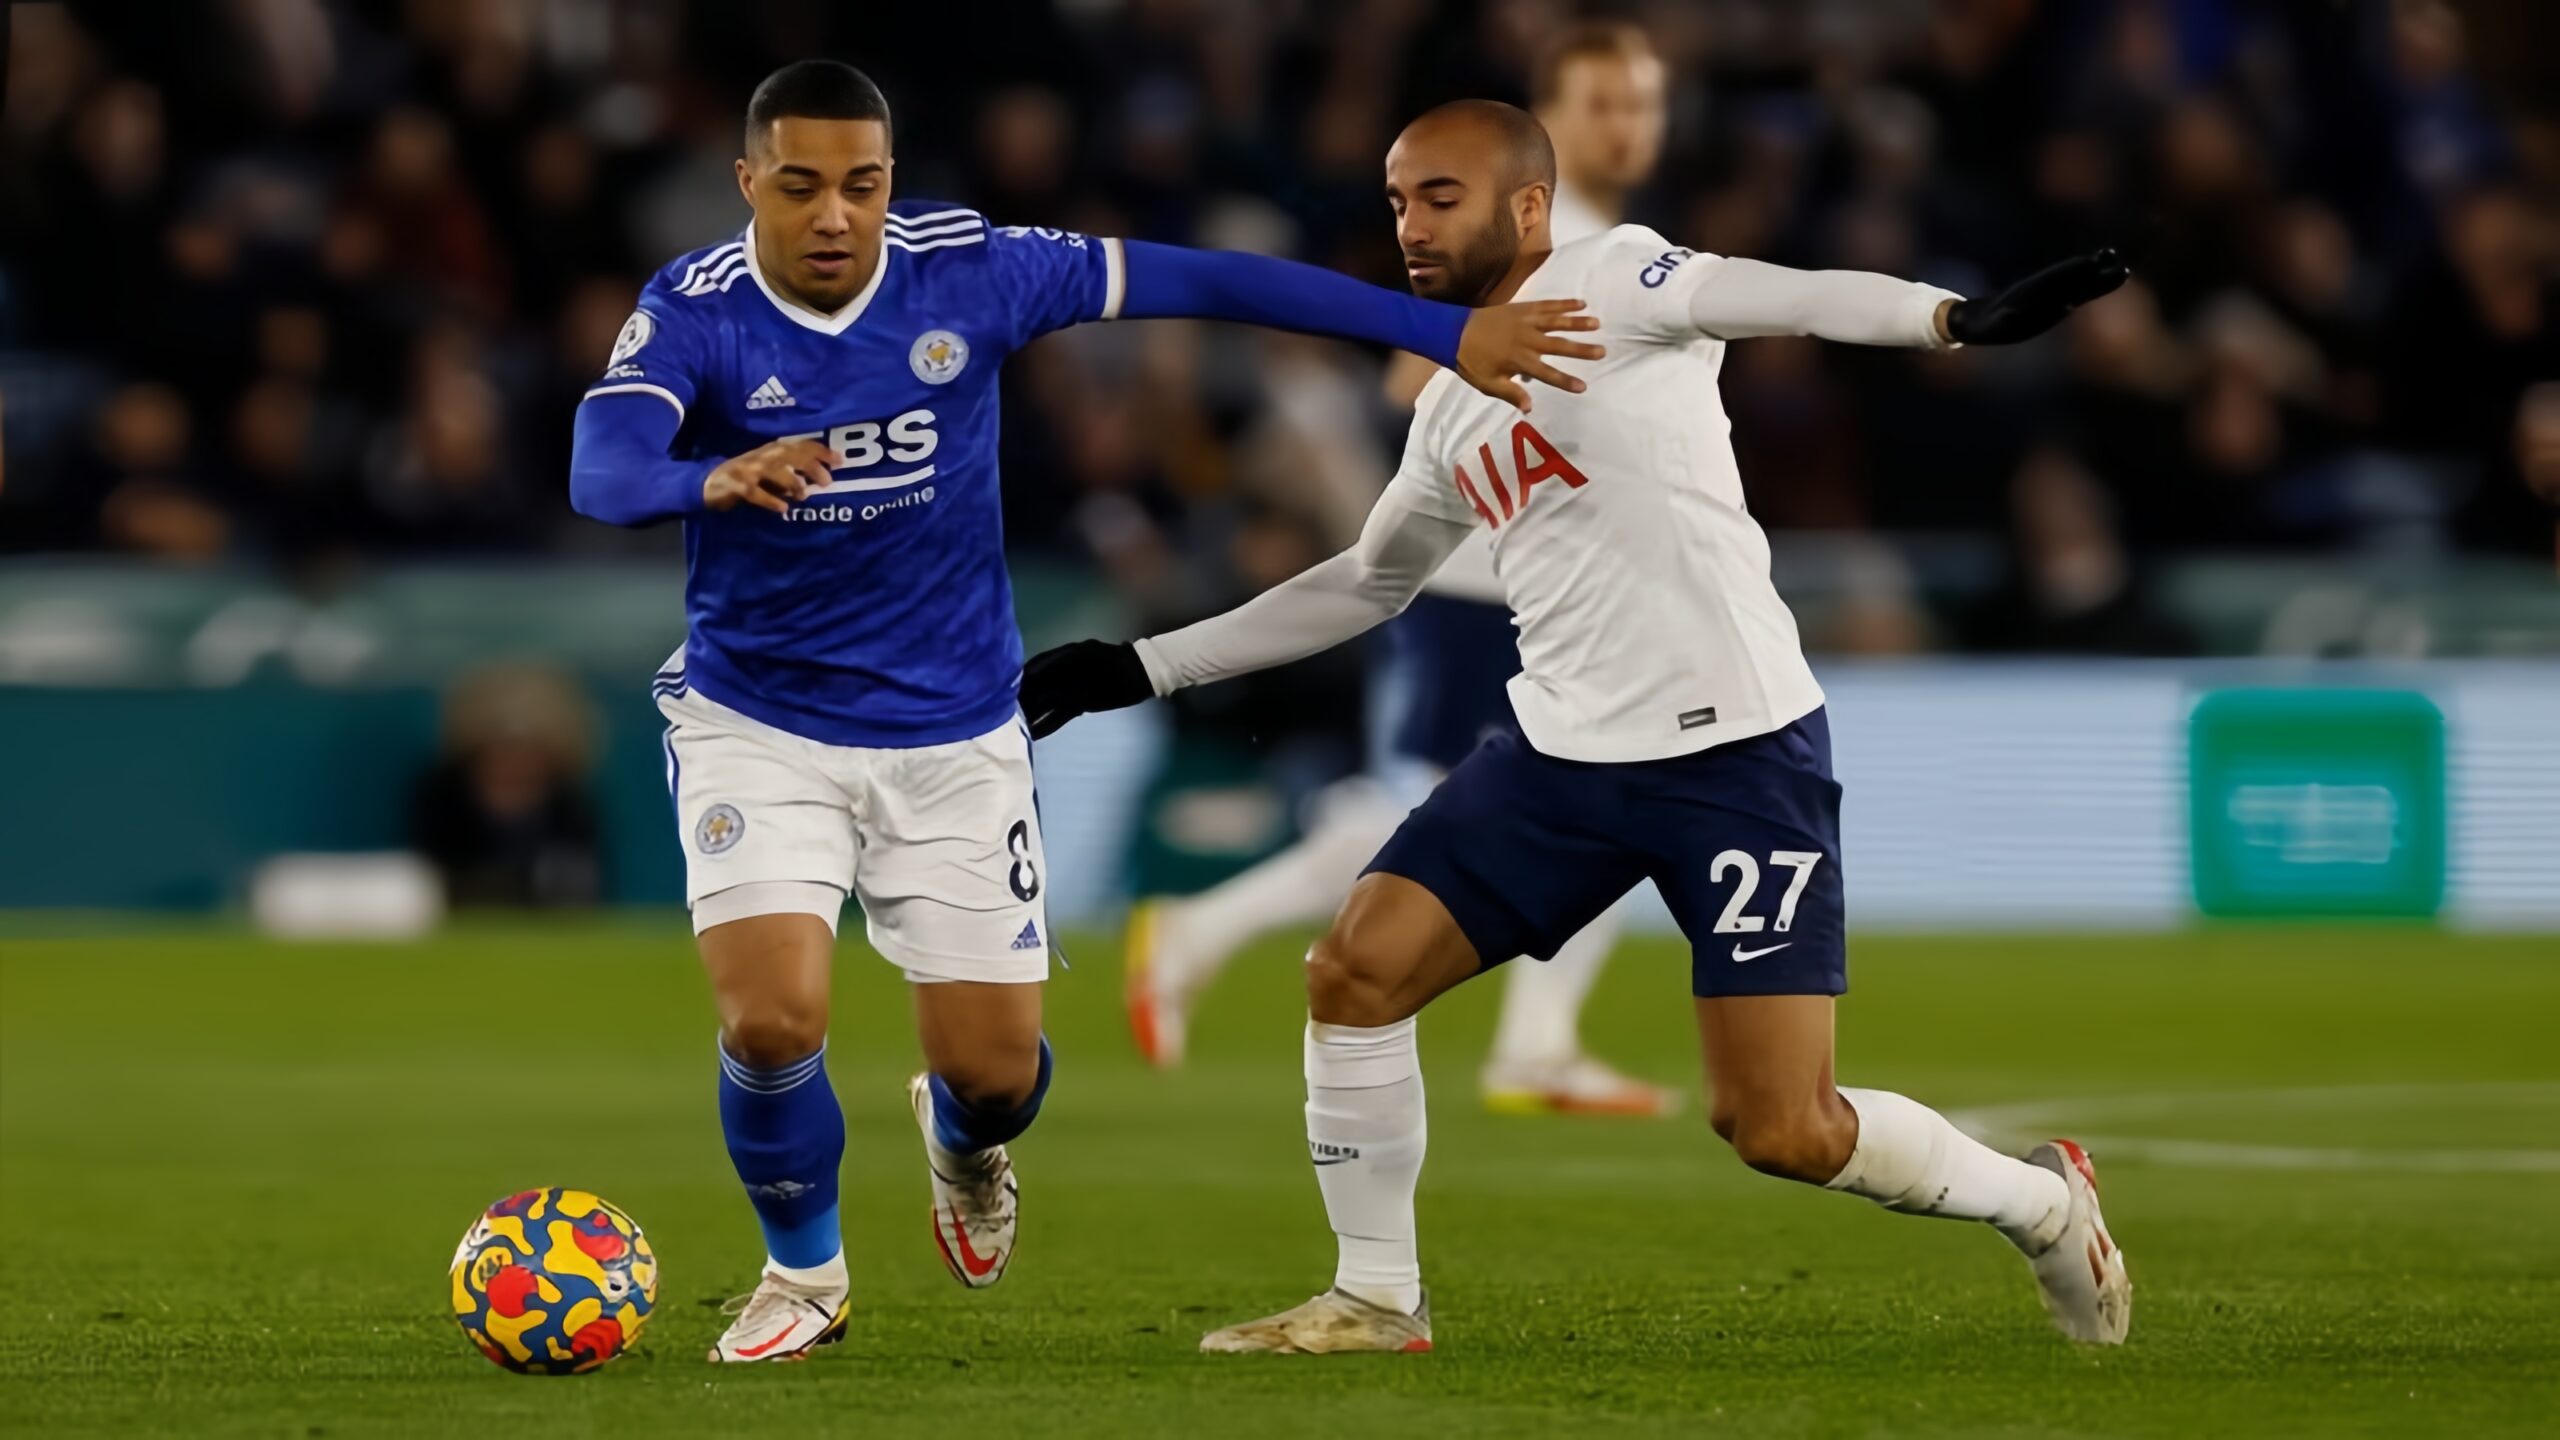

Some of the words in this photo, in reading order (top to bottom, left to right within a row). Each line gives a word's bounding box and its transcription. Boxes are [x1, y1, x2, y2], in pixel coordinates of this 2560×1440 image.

[777, 409, 938, 470] BS
[1454, 420, 1589, 530] AIA
[782, 504, 852, 521] trade
[1008, 820, 1039, 902] 8
[1710, 849, 1822, 933] 27
